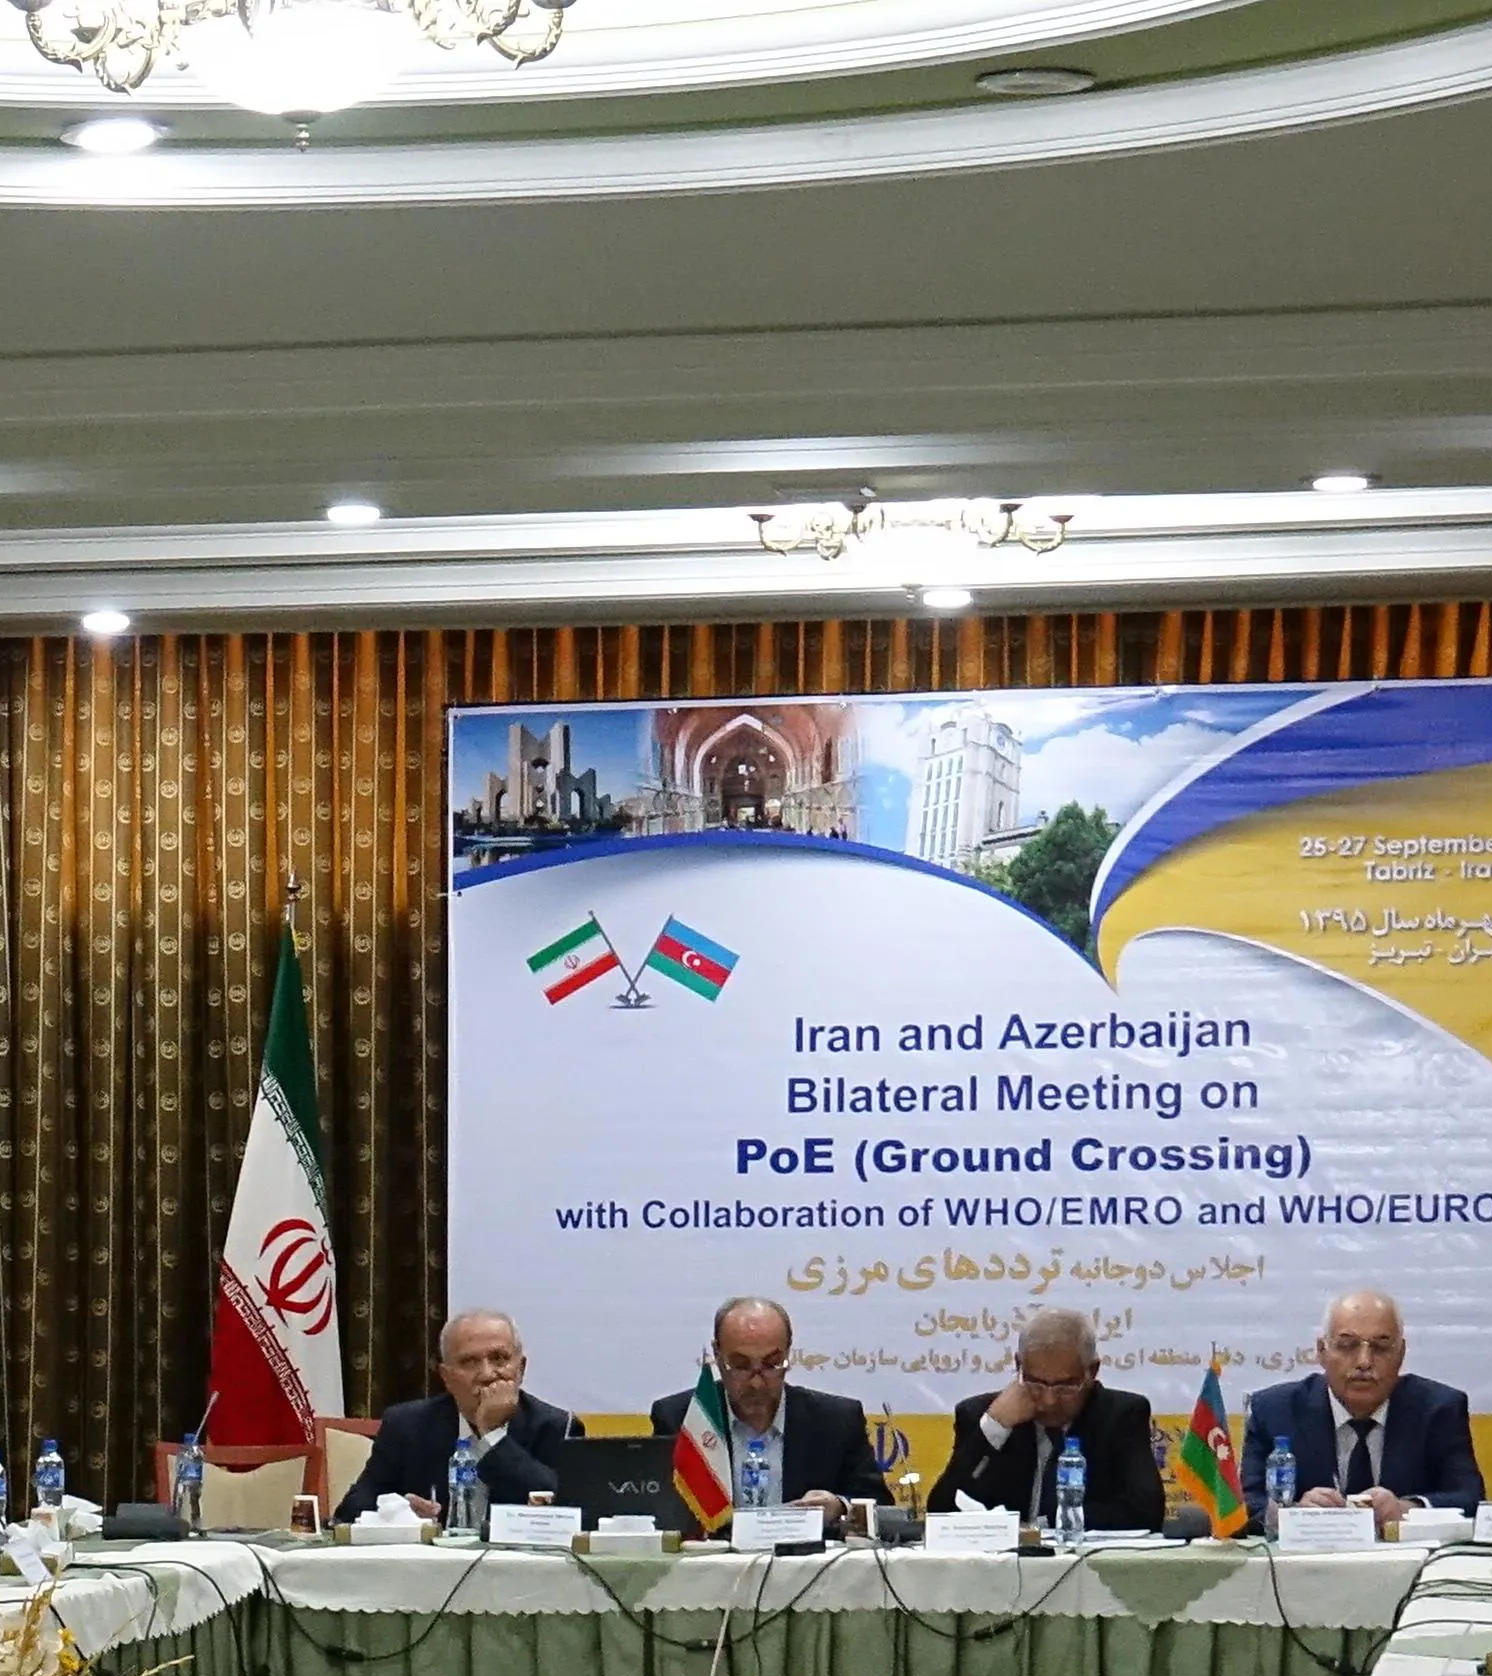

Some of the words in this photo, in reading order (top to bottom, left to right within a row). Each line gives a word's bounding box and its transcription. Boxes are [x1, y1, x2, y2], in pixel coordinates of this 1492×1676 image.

[1300, 836, 1366, 858] 25-27
[1364, 860, 1436, 881] Tabriz
[1367, 940, 1433, 965] تبریز
[795, 1016, 881, 1053] Iran
[898, 1014, 983, 1051] and
[998, 1011, 1251, 1057] Azerbaijan
[787, 1075, 977, 1113] Bilateral
[997, 1073, 1182, 1119] Meeting
[1200, 1079, 1259, 1110] on
[735, 1138, 834, 1175] PoE
[855, 1137, 1052, 1182] (Ground
[1070, 1134, 1313, 1180] Crossing)
[555, 1199, 629, 1229] with
[642, 1198, 884, 1230] Collaboration
[898, 1197, 934, 1227] of
[944, 1196, 1183, 1227] WHO/EMRO
[1197, 1194, 1266, 1225] and
[786, 1253, 889, 1296] مرزی
[897, 1246, 1063, 1295] ترددهای
[1170, 1254, 1265, 1289] اجلاس
[833, 1348, 898, 1373] سازمان
[607, 1480, 660, 1495] VAIO
